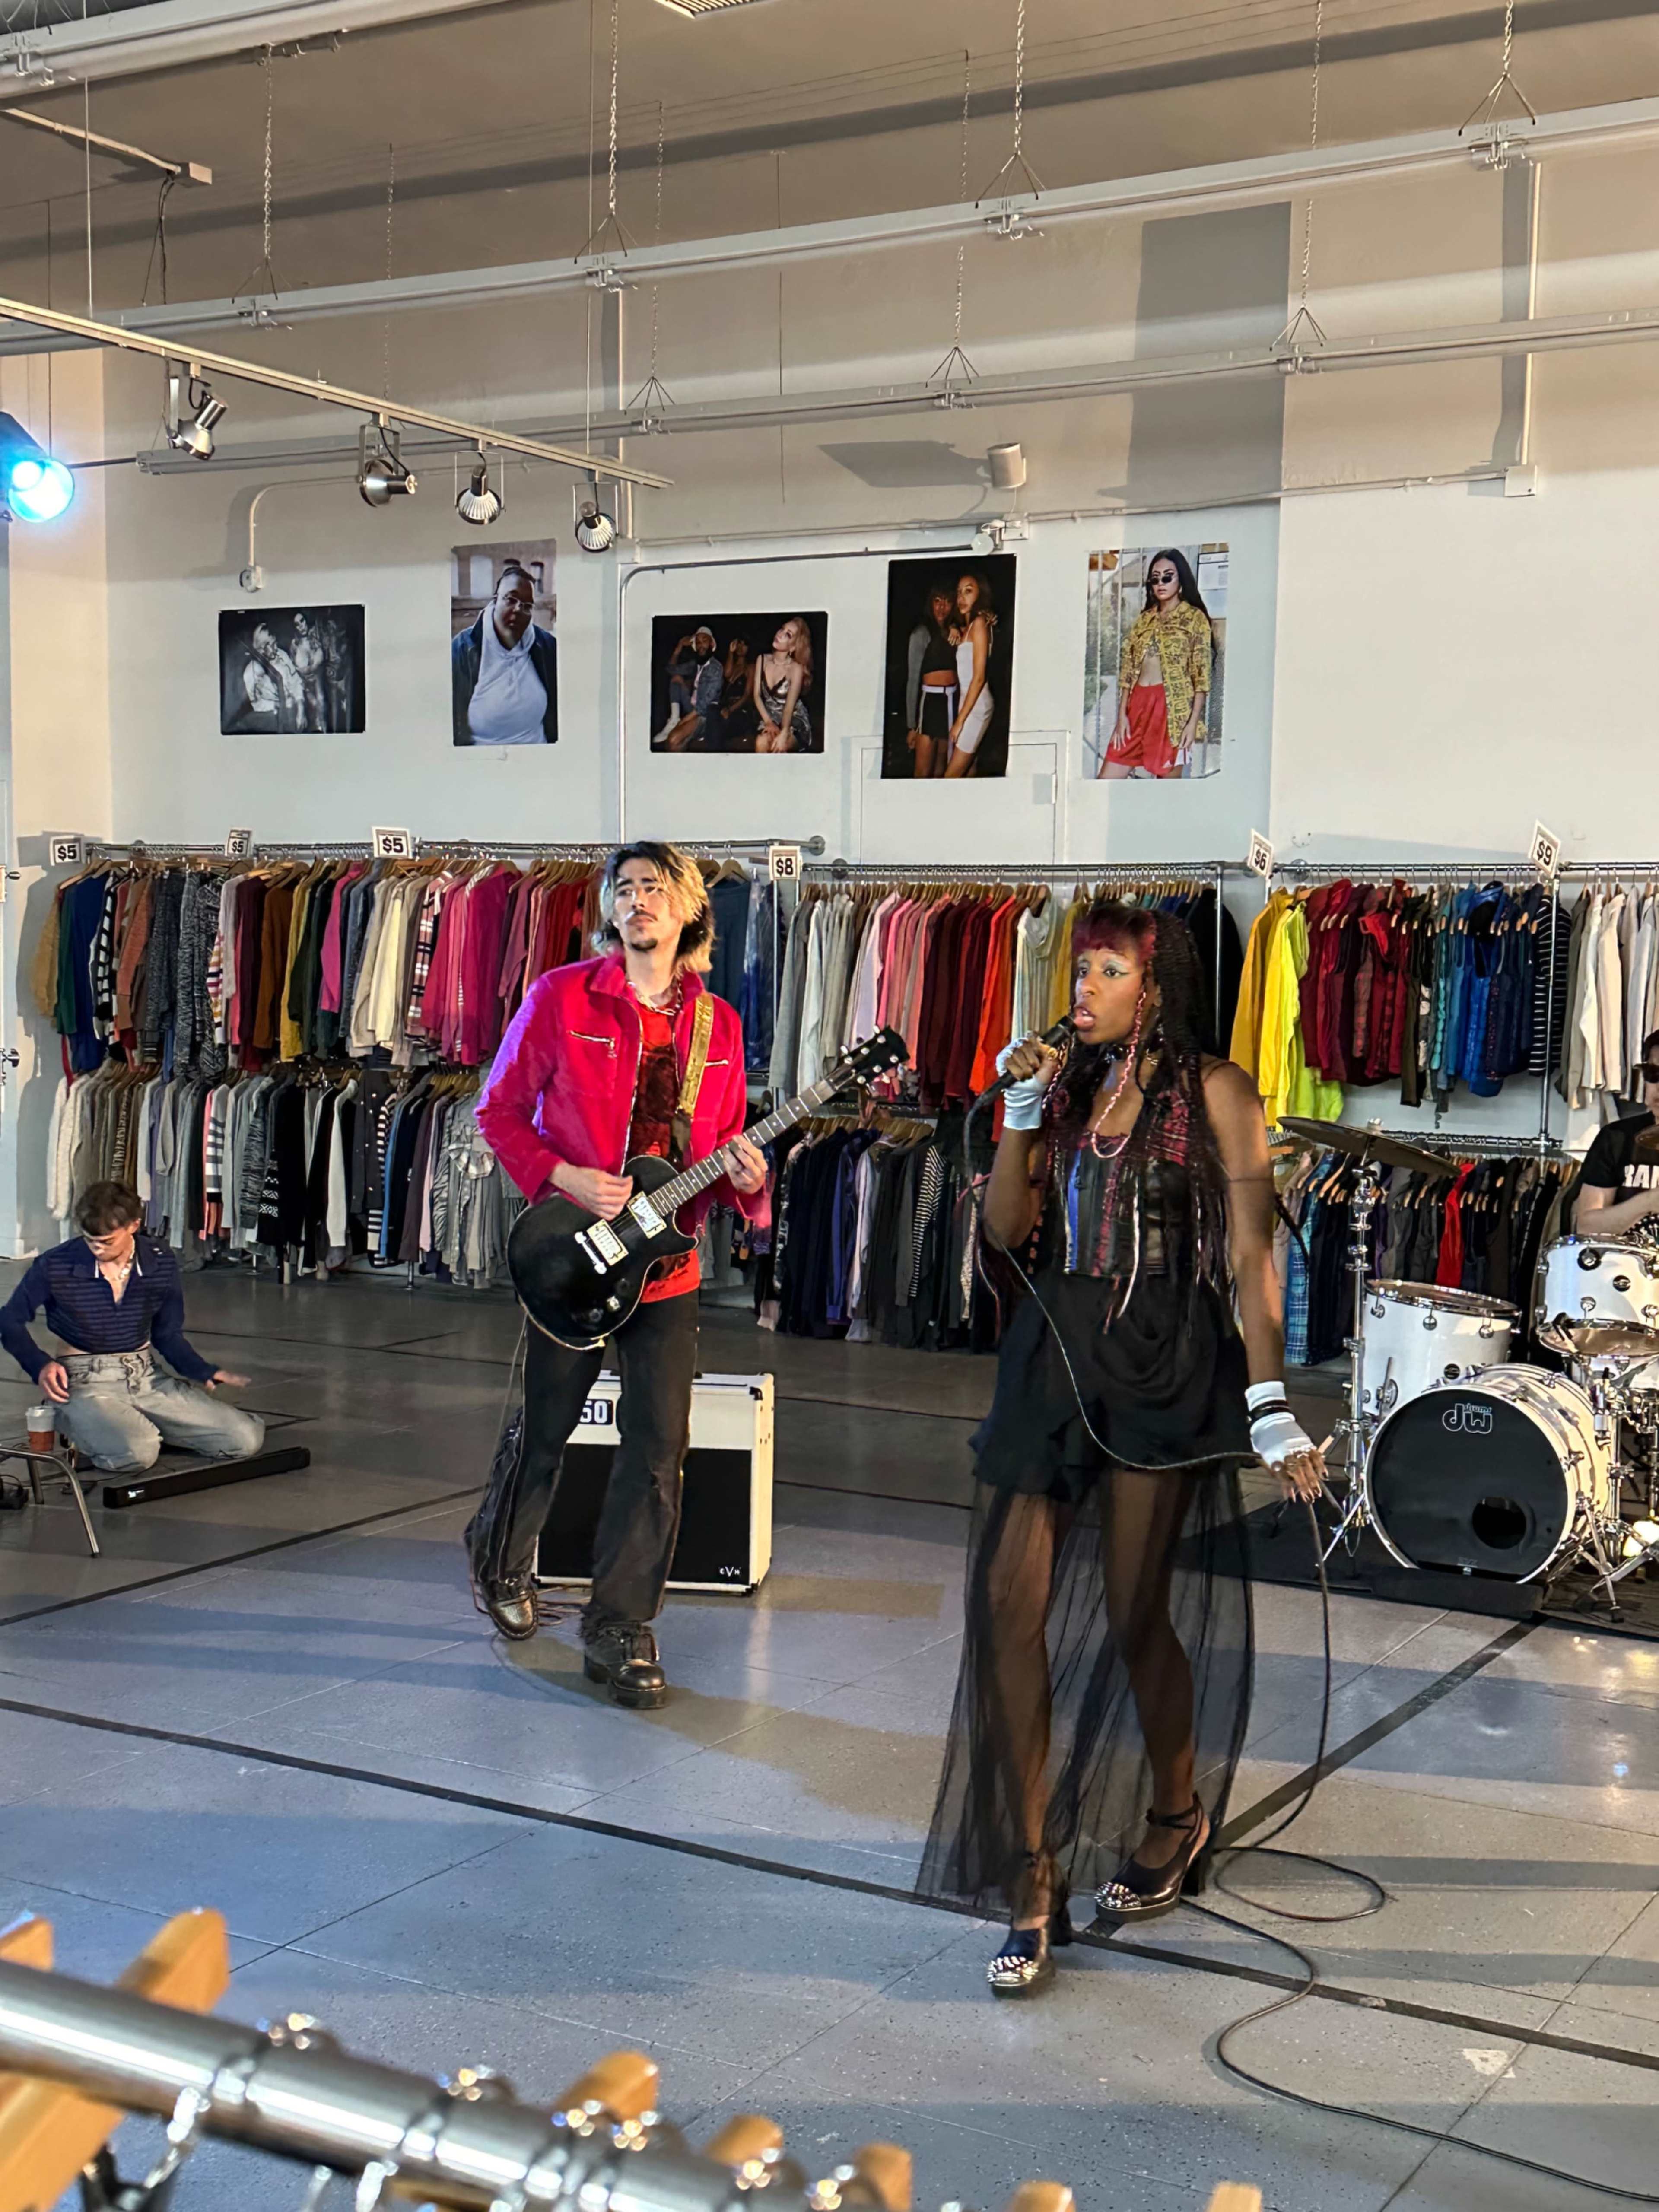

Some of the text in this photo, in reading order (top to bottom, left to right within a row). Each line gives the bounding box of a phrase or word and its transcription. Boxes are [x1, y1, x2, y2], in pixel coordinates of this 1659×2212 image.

[57, 845, 77, 861] $5
[232, 840, 244, 853] $5
[382, 836, 403, 854] $5
[1537, 840, 1552, 866] $9
[776, 858, 793, 876] $8
[1255, 849, 1267, 871] $6
